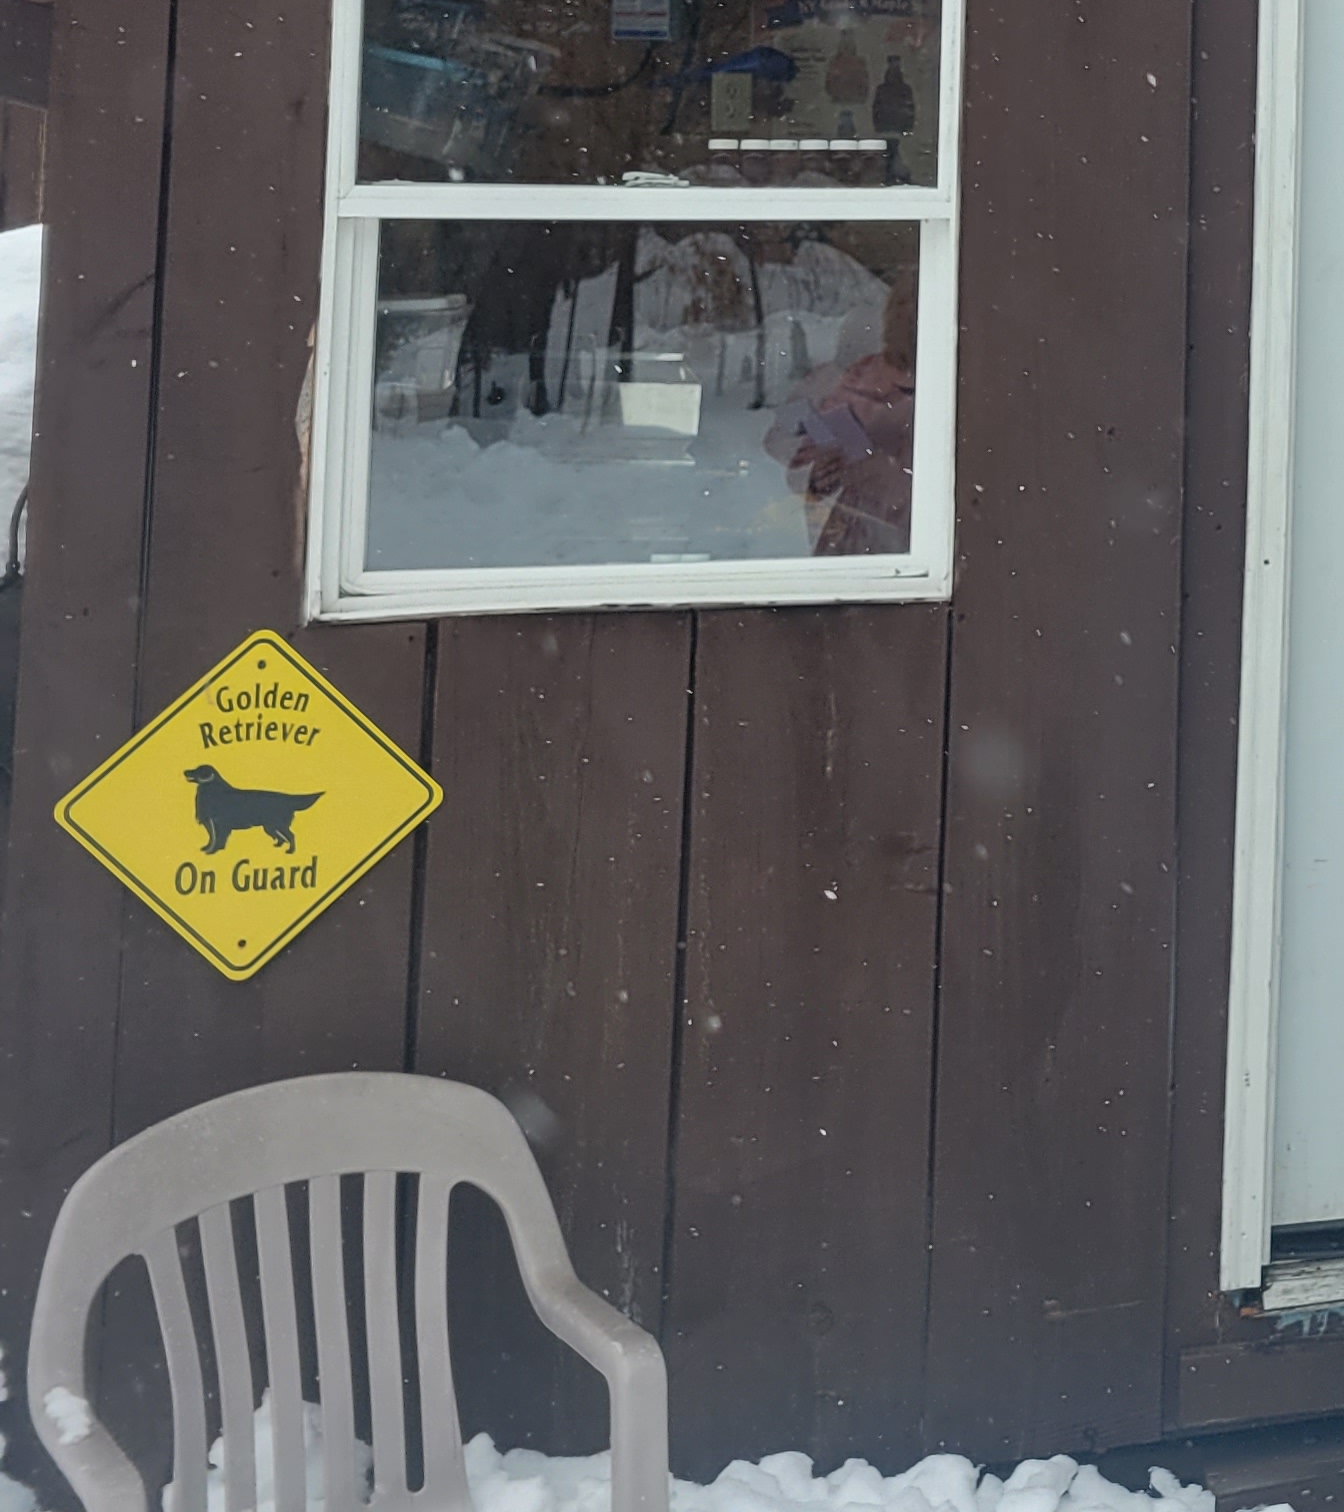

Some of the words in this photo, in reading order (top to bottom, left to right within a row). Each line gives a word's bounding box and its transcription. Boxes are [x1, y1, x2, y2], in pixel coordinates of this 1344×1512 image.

[216, 682, 310, 713] Golden
[199, 713, 321, 749] Retriever
[175, 861, 216, 896] On
[231, 855, 318, 893] Guard
